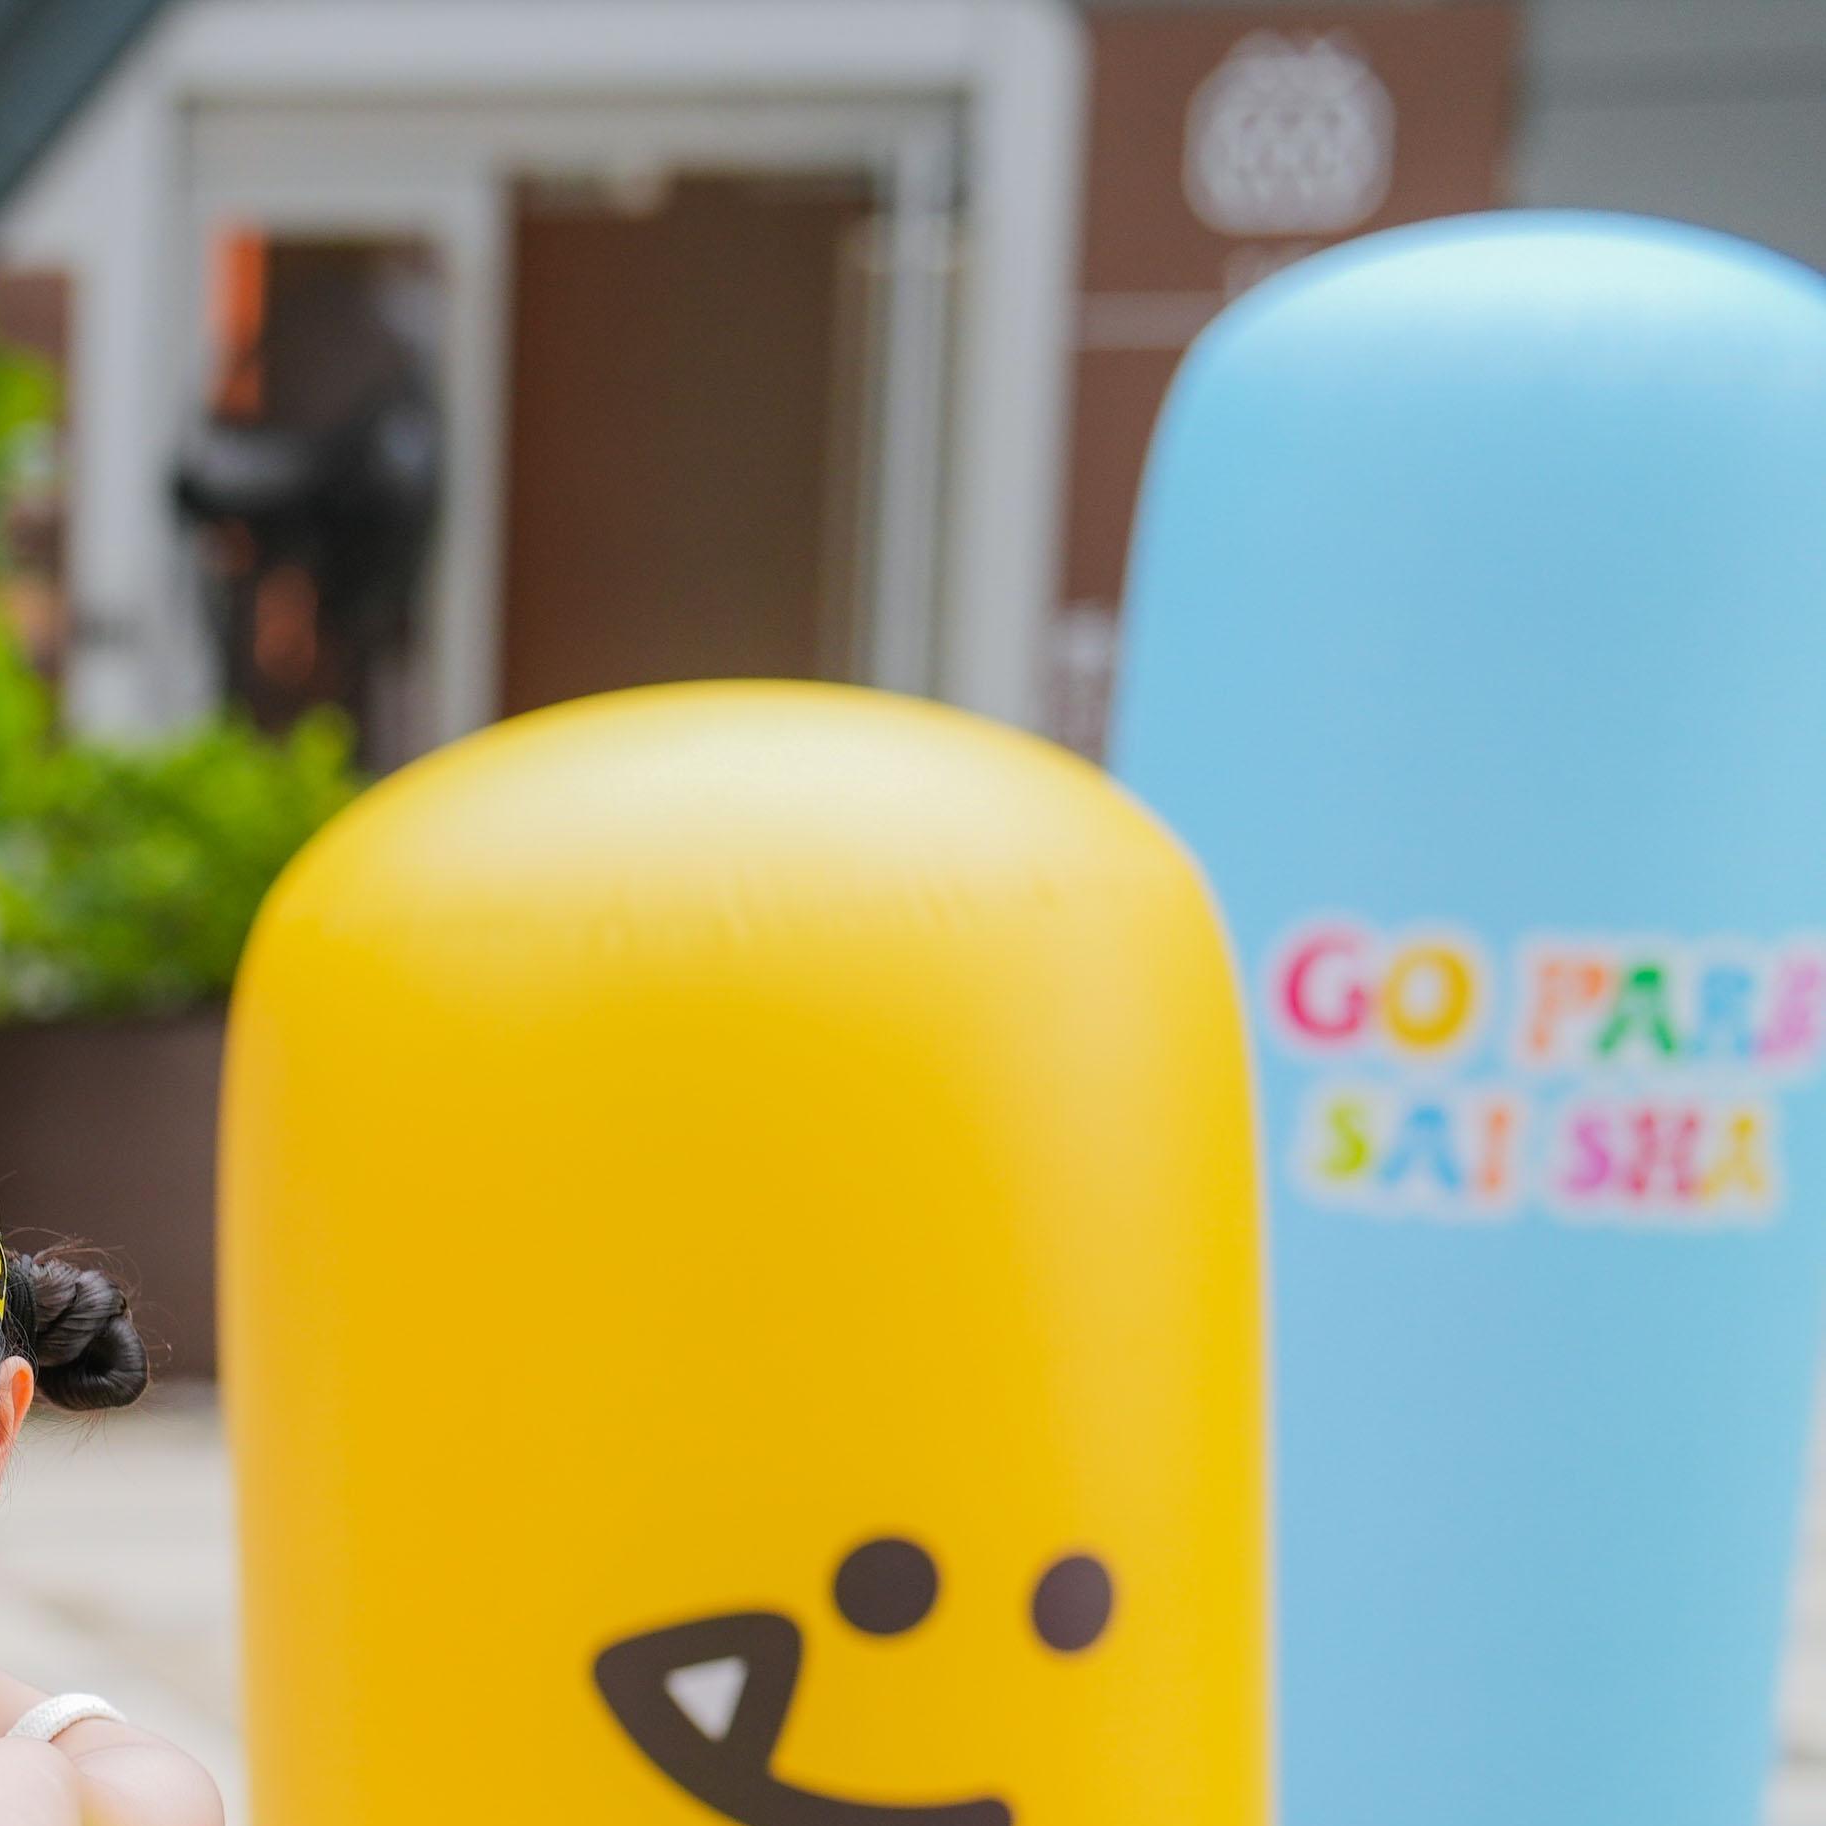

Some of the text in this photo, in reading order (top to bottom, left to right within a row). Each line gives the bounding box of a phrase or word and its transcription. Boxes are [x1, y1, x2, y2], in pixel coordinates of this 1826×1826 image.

[1275, 922, 1475, 1052] GO
[1321, 1098, 1767, 1202] SAI SHA
